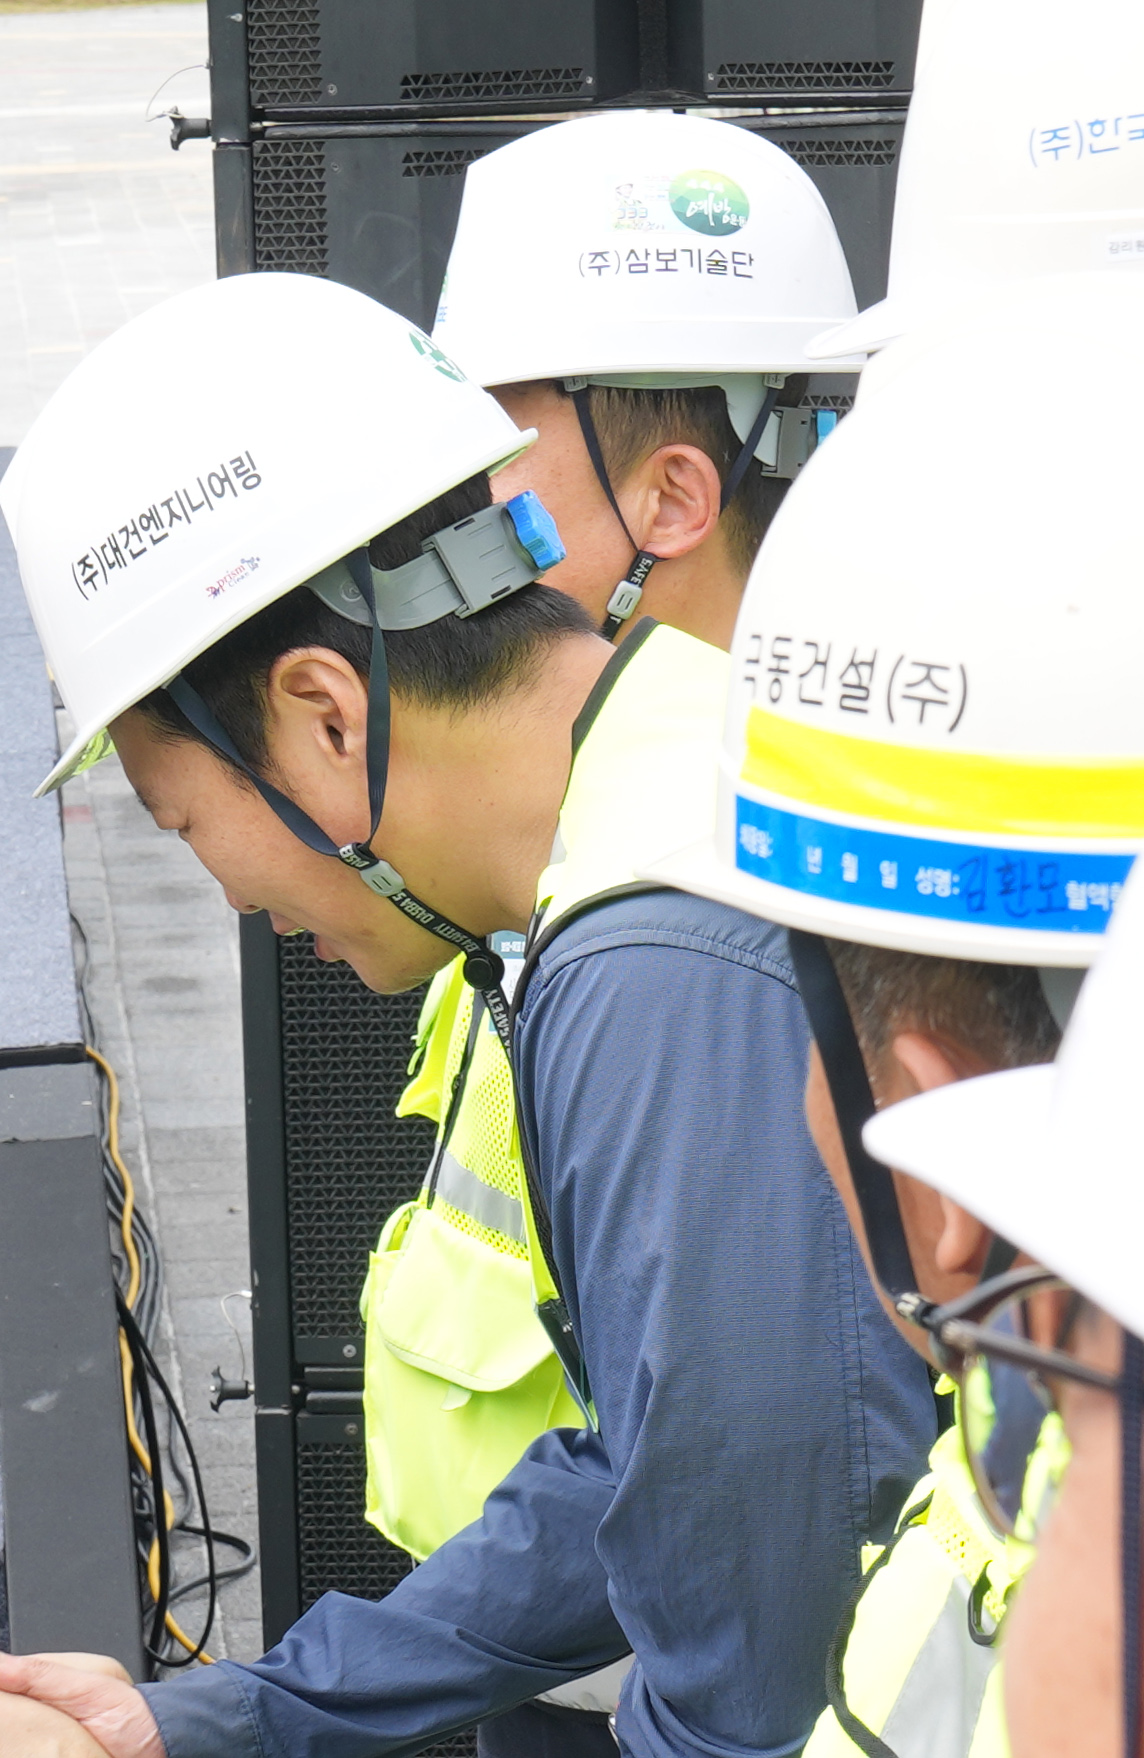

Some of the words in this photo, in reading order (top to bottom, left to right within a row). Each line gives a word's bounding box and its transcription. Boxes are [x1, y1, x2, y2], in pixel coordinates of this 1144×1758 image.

[578, 248, 755, 279] (주)삼보기술단
[71, 450, 262, 601] (주)대건엔지니어링
[216, 564, 247, 593] prism
[914, 866, 961, 898] 성명:
